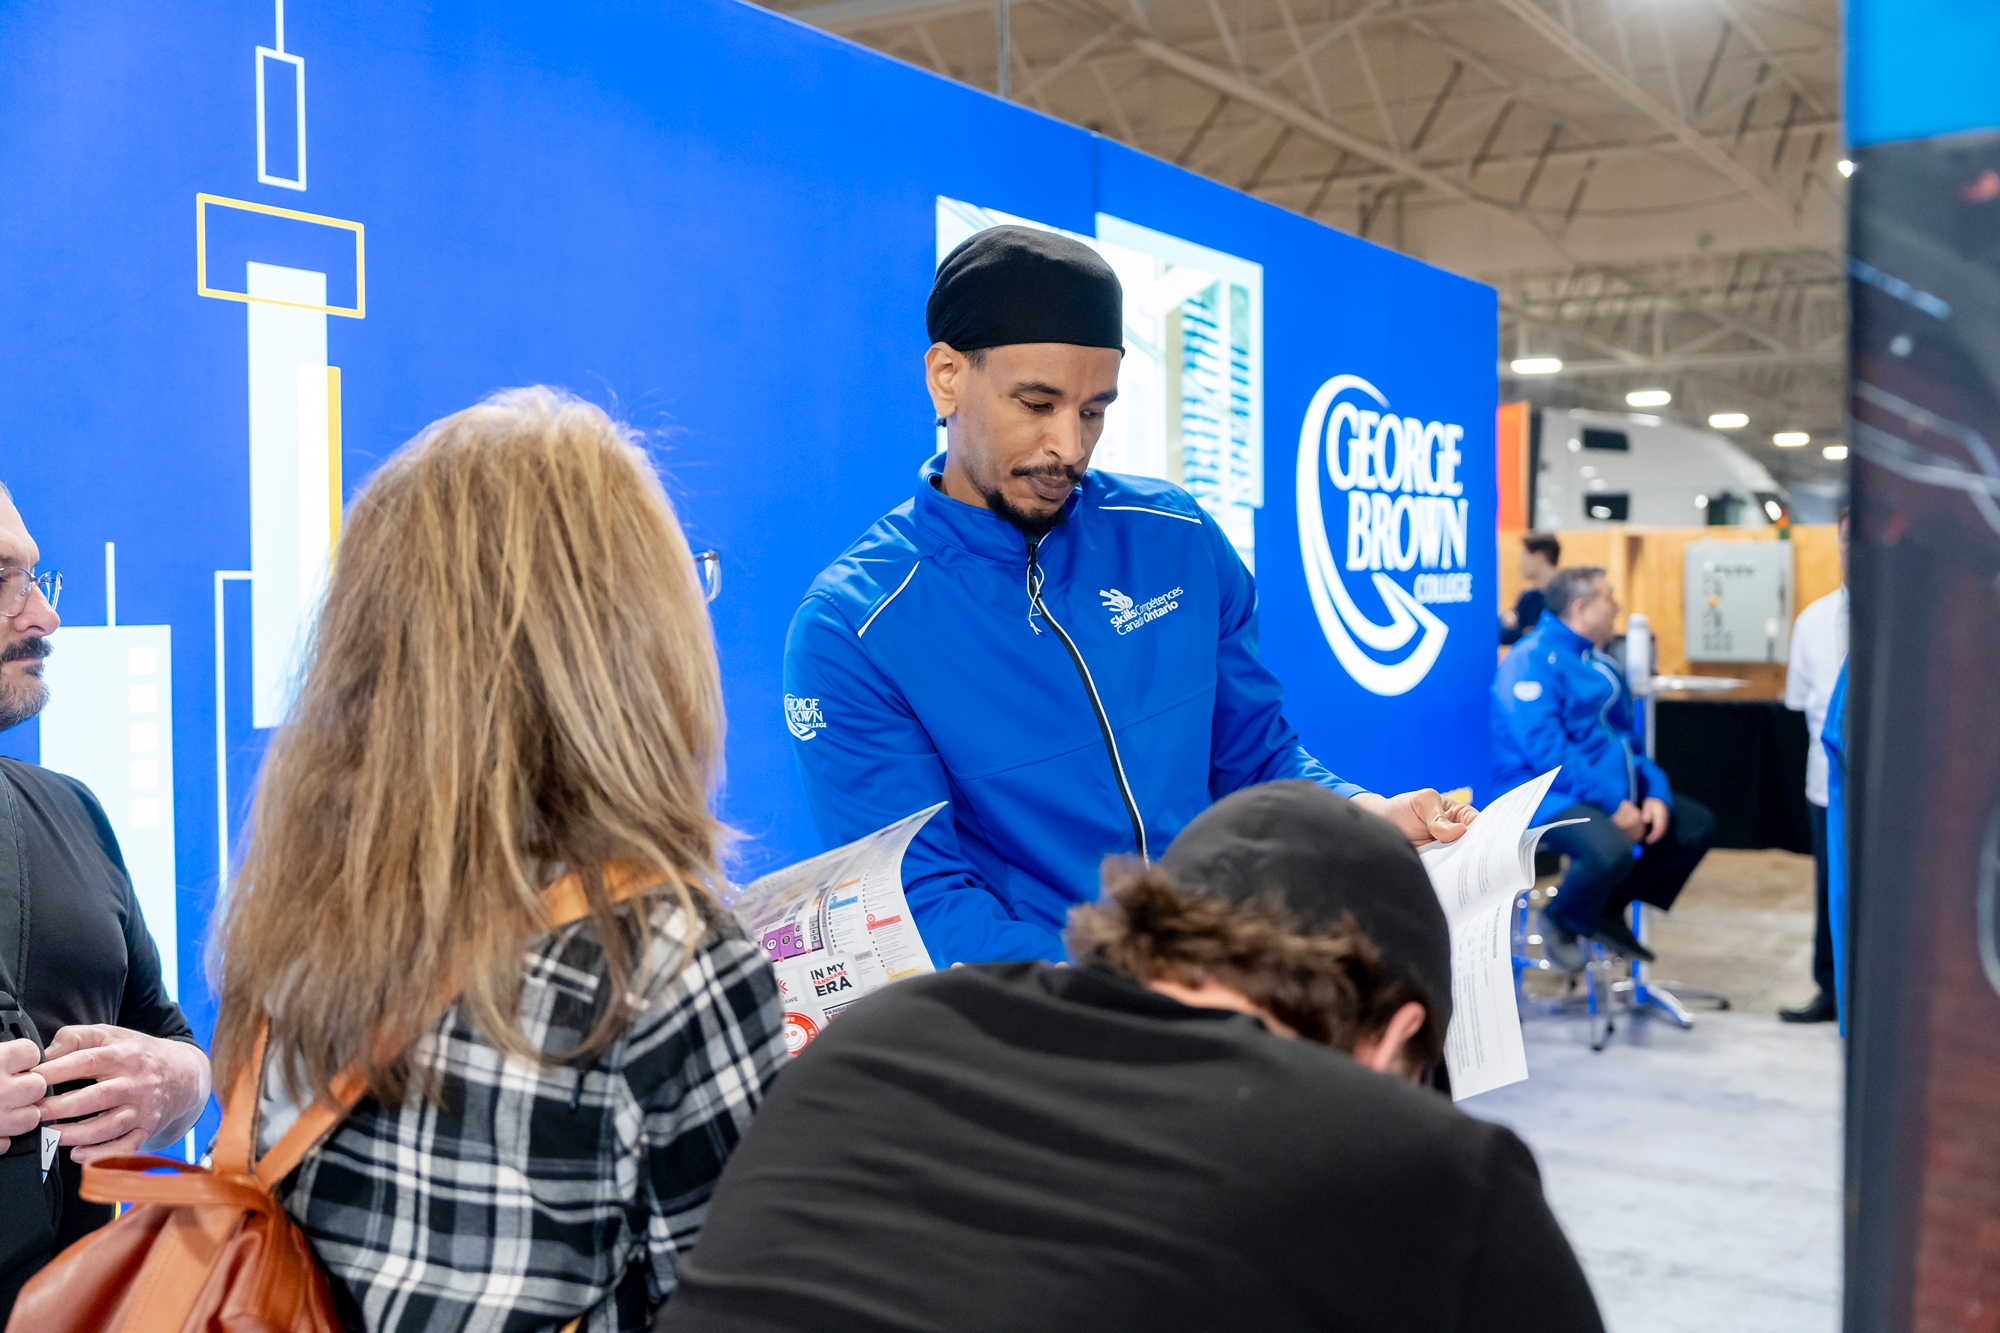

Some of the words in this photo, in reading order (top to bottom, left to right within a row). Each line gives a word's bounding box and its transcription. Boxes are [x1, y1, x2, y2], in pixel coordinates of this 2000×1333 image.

[1326, 401, 1464, 497] GEORGE
[1346, 490, 1469, 572] BROWN
[1414, 572, 1473, 604] COLLEGE
[1110, 608, 1137, 628] Skills
[1143, 601, 1179, 623] Ontario
[791, 710, 824, 722] ROWN
[810, 968, 825, 980] IN
[826, 962, 845, 975] MY
[813, 970, 848, 985] FANSHAWE
[815, 976, 853, 997] ERA
